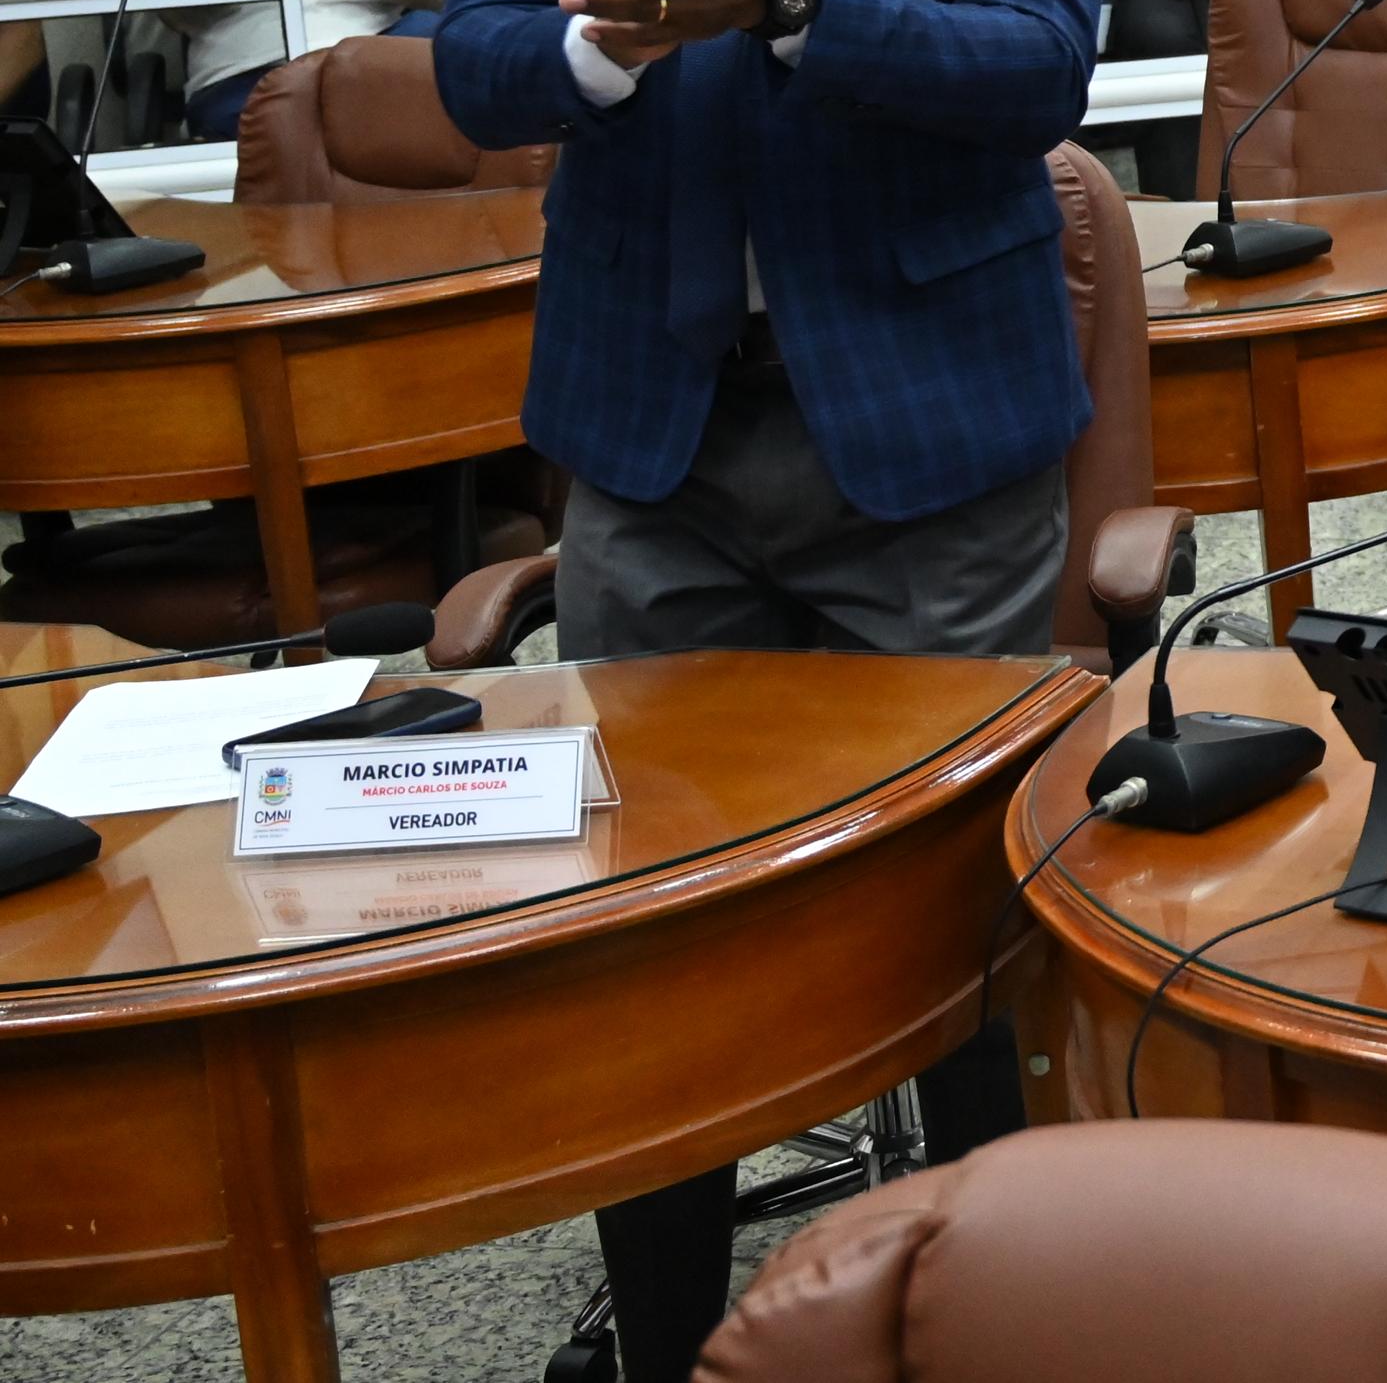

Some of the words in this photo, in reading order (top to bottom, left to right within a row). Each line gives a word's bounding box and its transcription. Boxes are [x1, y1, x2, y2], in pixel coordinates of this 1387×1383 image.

[343, 762, 426, 782] MARCIO
[432, 756, 528, 776] SIMPATIA
[408, 783, 451, 794] CARLOS
[454, 782, 467, 791] DE
[471, 780, 507, 791] SOUZA
[254, 809, 292, 824] CMNI
[389, 811, 477, 830] VEREADOR
